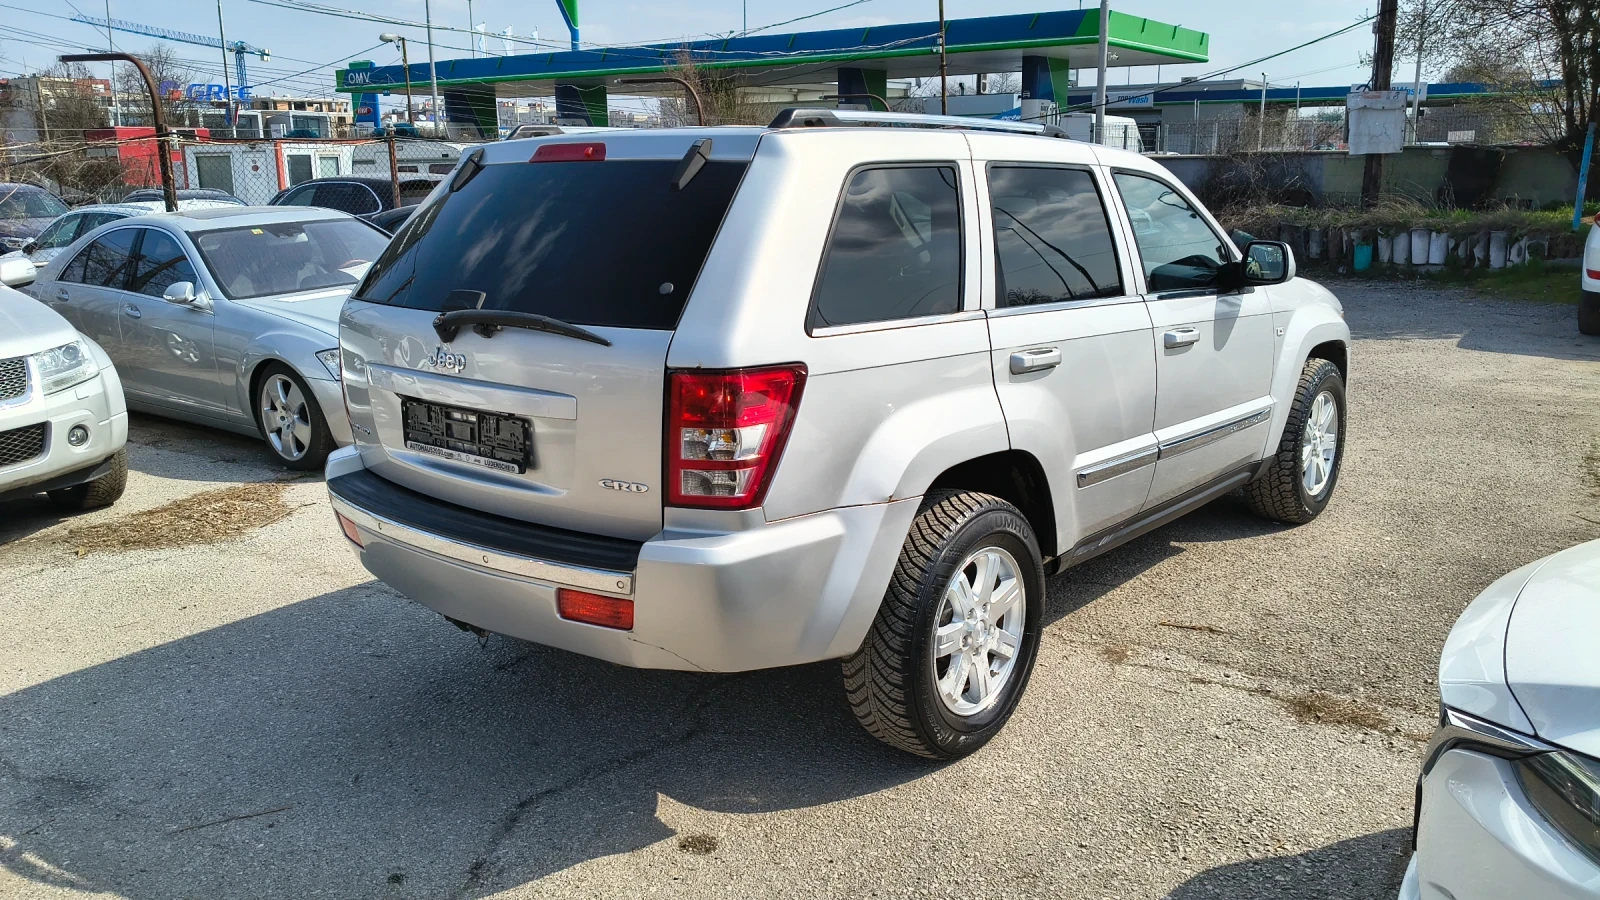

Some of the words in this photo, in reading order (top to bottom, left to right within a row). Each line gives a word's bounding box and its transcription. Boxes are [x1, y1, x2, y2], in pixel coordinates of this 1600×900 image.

[348, 71, 370, 84] OMV
[186, 83, 252, 101] GREE
[427, 346, 467, 374] Jeep
[597, 478, 649, 493] CRD
